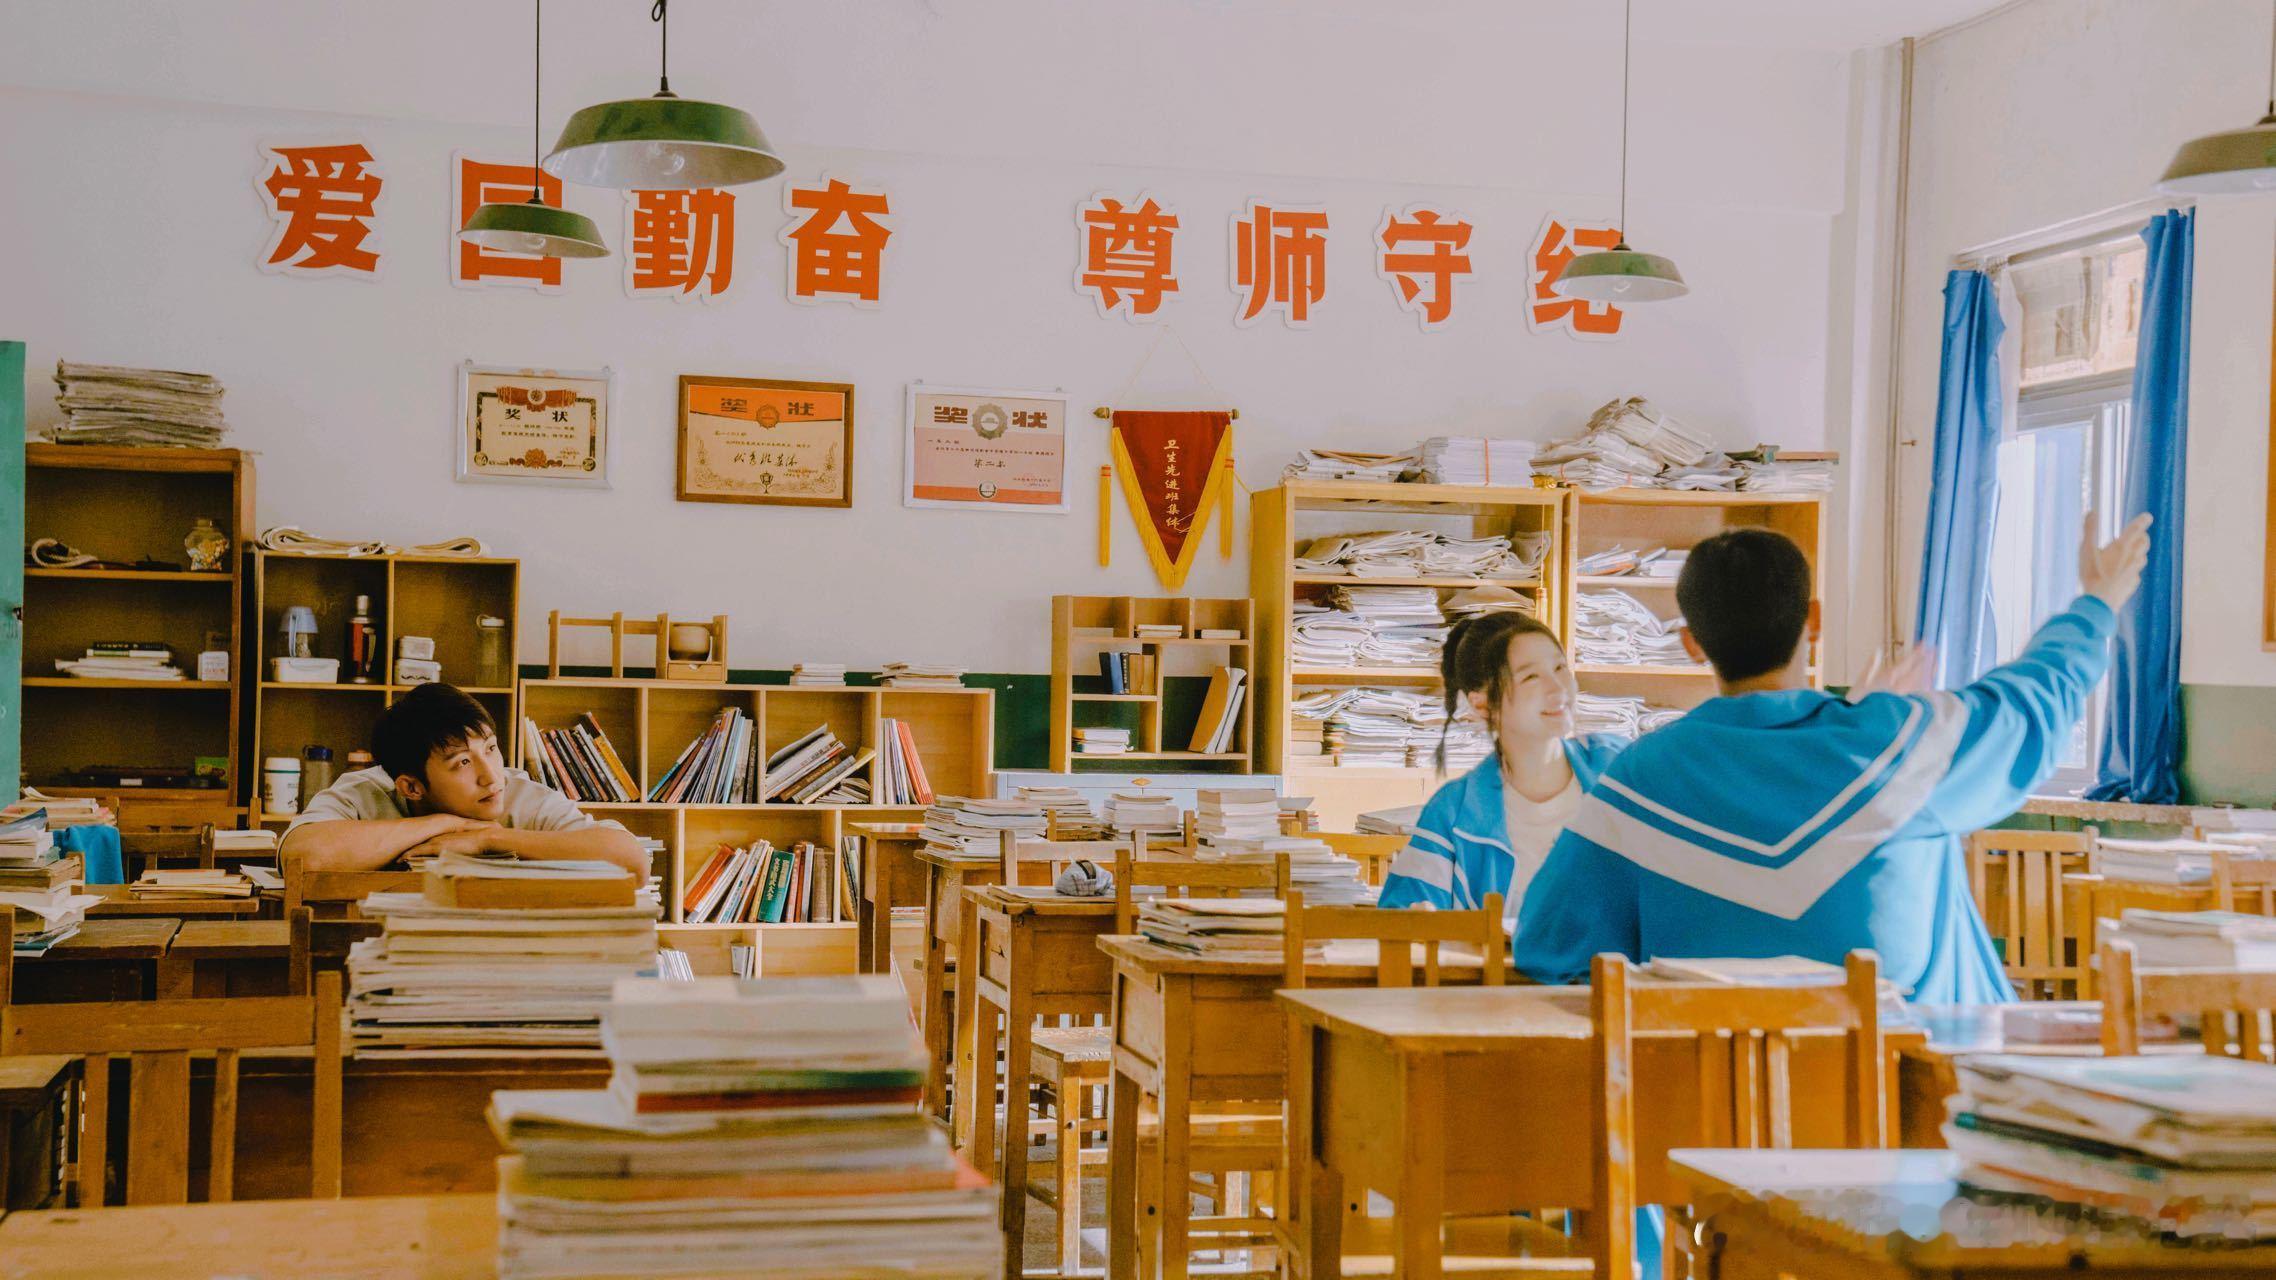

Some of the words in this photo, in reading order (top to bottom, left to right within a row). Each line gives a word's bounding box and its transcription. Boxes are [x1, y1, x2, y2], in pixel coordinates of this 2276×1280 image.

[1082, 198, 1623, 334] 尊师守纪
[505, 408, 569, 423] 奖状
[721, 397, 815, 416] 奖状
[934, 405, 1048, 429] 奖状
[1164, 439, 1181, 528] 卫生先进班集体
